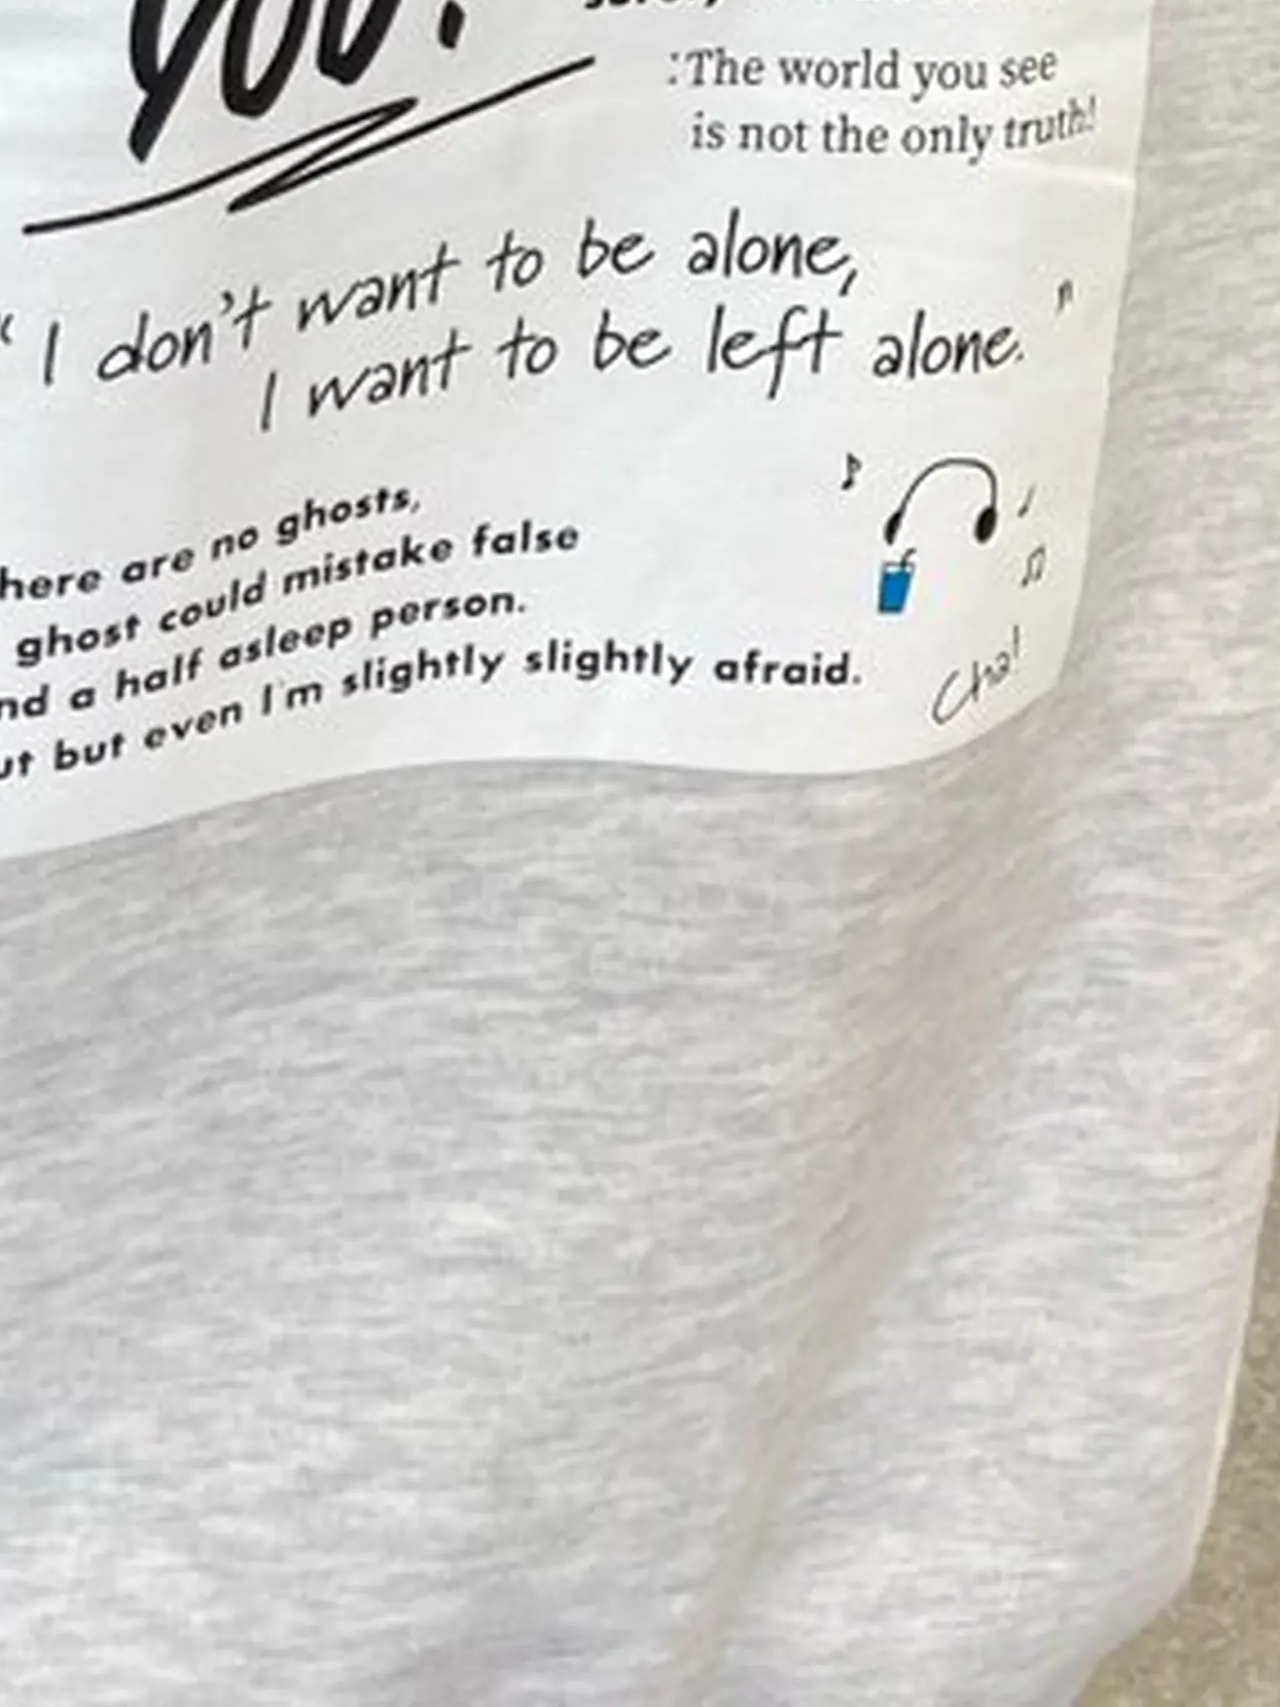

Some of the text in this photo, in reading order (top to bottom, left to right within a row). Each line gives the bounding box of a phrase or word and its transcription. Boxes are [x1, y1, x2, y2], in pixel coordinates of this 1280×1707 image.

[666, 45, 1058, 104] :The world you see
[690, 95, 1097, 167] is not the only truth!
[95, 282, 274, 383] don't
[296, 239, 463, 334] want
[484, 228, 545, 293] to
[575, 216, 657, 281] be
[686, 205, 859, 298] alone,
[259, 369, 278, 434] I
[307, 325, 474, 419] want
[494, 314, 560, 381] to
[592, 307, 673, 373] be
[705, 302, 845, 402] left
[871, 307, 1026, 381] alone.
[14, 612, 142, 670] ghost
[157, 567, 268, 634] could
[282, 533, 455, 597] mistake
[471, 516, 581, 559] false
[120, 545, 197, 586] are
[210, 524, 261, 563] no
[274, 485, 422, 548] ghosts,
[52, 732, 128, 774] but
[142, 699, 244, 752] even
[260, 680, 325, 718] I'm
[341, 641, 507, 698] slightly
[523, 636, 695, 688] slightly
[712, 646, 863, 688] afraid.
[68, 686, 97, 712] a
[114, 645, 206, 703] half
[217, 615, 354, 672] asleep
[368, 591, 527, 643] person.
